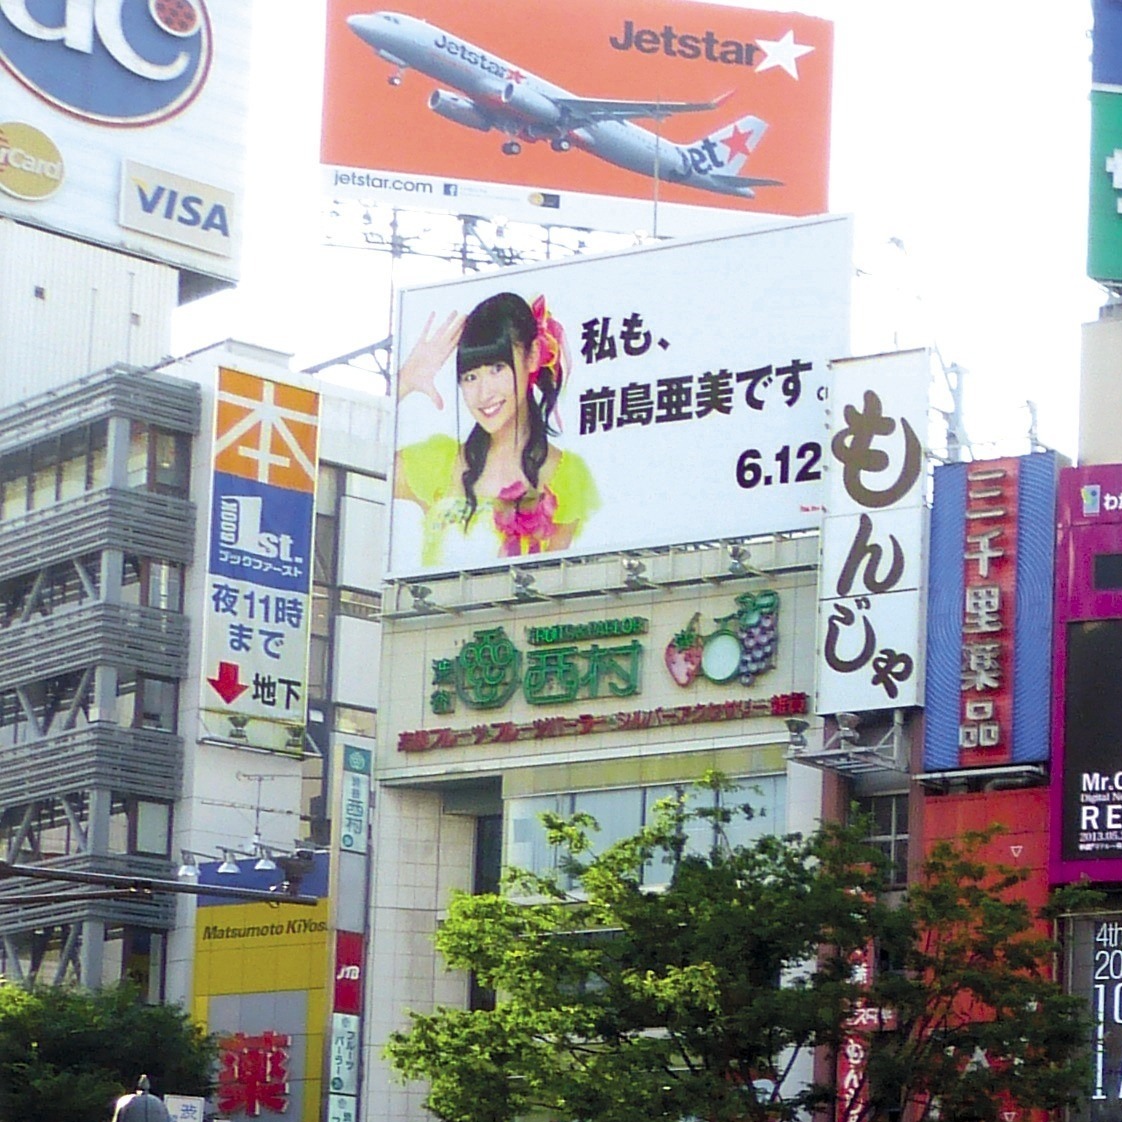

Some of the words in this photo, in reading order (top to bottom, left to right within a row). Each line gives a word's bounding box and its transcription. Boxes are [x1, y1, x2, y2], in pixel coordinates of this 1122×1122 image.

[433, 33, 508, 80] Jetstar
[609, 20, 761, 67] Jetstar
[333, 171, 433, 194] jetstar.com
[133, 176, 230, 238] VISA
[580, 312, 670, 365] 私も、
[579, 359, 828, 436] 前島亜美です。
[735, 441, 822, 489] 6.12
[220, 496, 238, 548] BOOK
[824, 389, 922, 700] もんじゃ
[219, 550, 303, 577] ブックファースト
[212, 582, 303, 630] 夜11時
[958, 468, 1006, 749] 三千里薬品
[228, 623, 285, 660] まで
[252, 671, 302, 710] 地下
[523, 639, 644, 705] 西村
[203, 922, 284, 941] Matsumoto
[286, 918, 328, 937] KiYos
[214, 1030, 291, 1117] 薬
